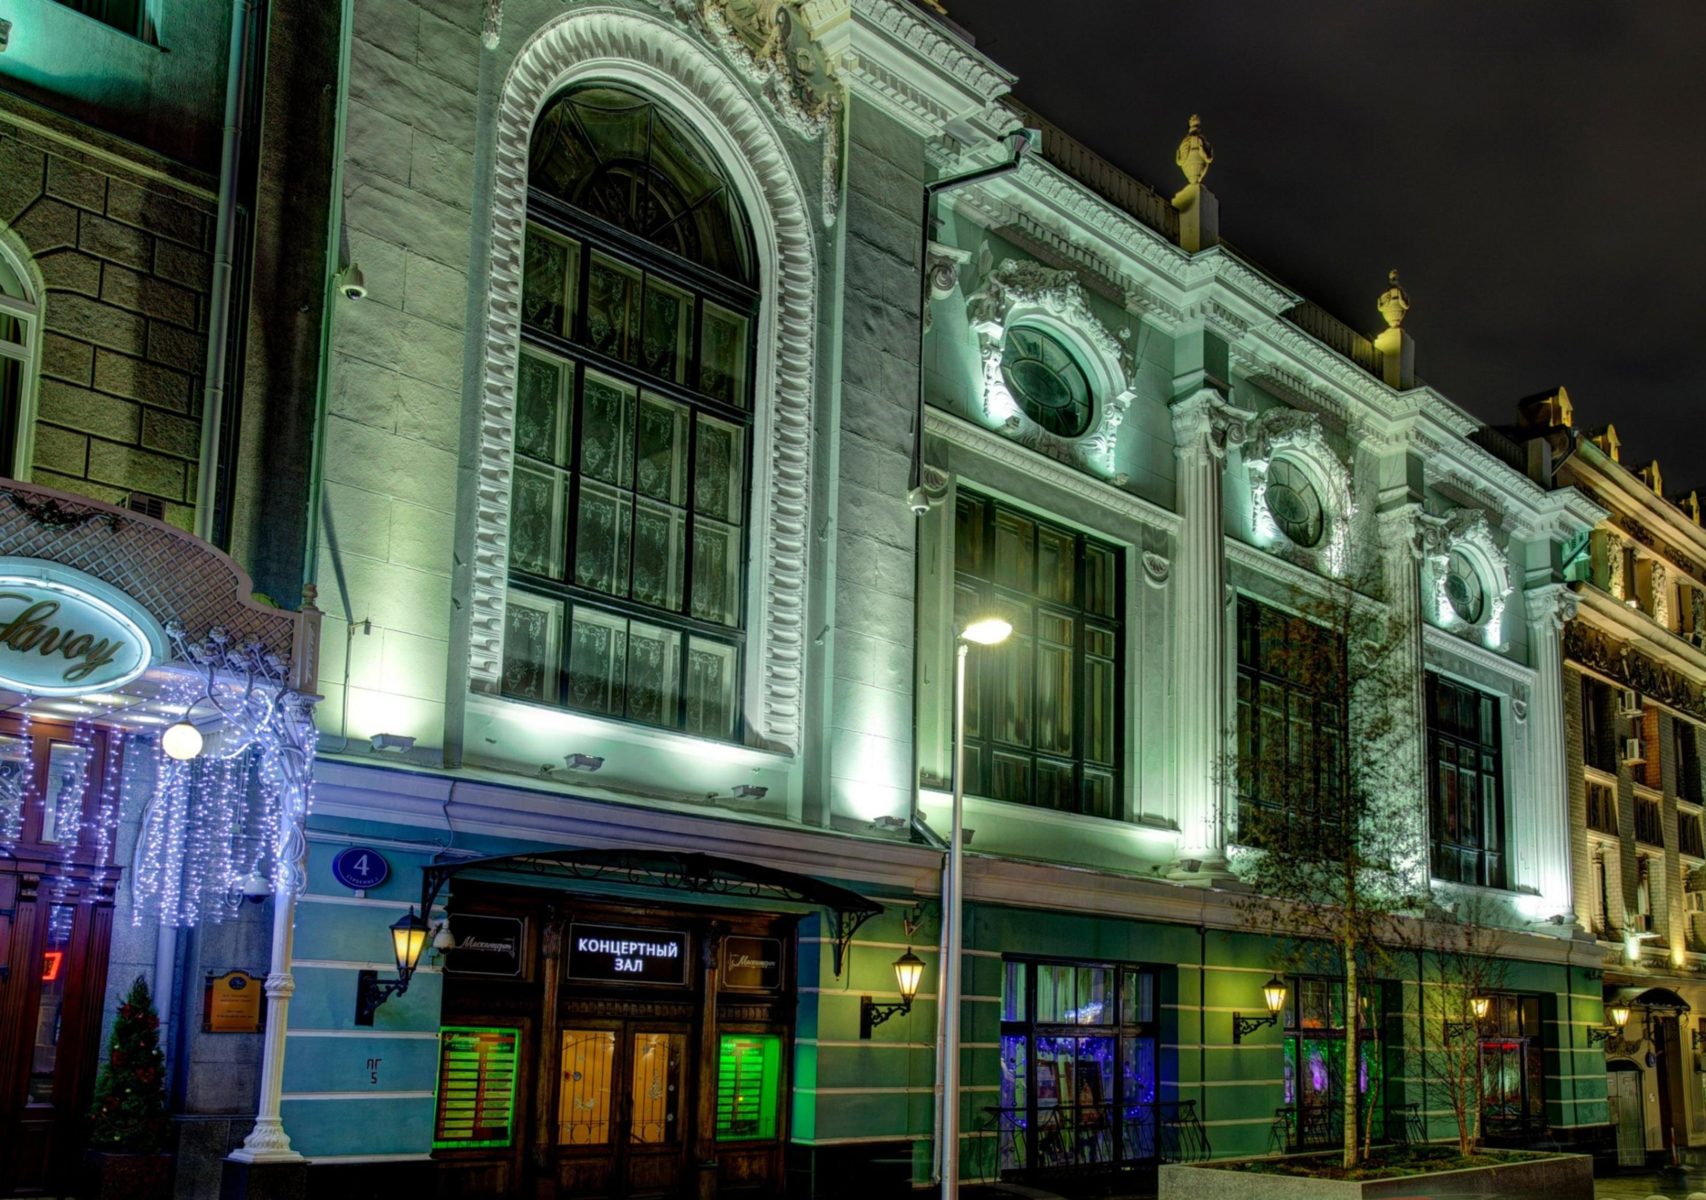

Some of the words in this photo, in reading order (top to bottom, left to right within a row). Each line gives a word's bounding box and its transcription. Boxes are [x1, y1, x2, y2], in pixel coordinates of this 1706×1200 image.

[353, 854, 370, 876] 4
[578, 938, 678, 958] КОНЦЕРТНЫЙ
[614, 958, 643, 972] ЗАЛ
[370, 1071, 378, 1084] 5
